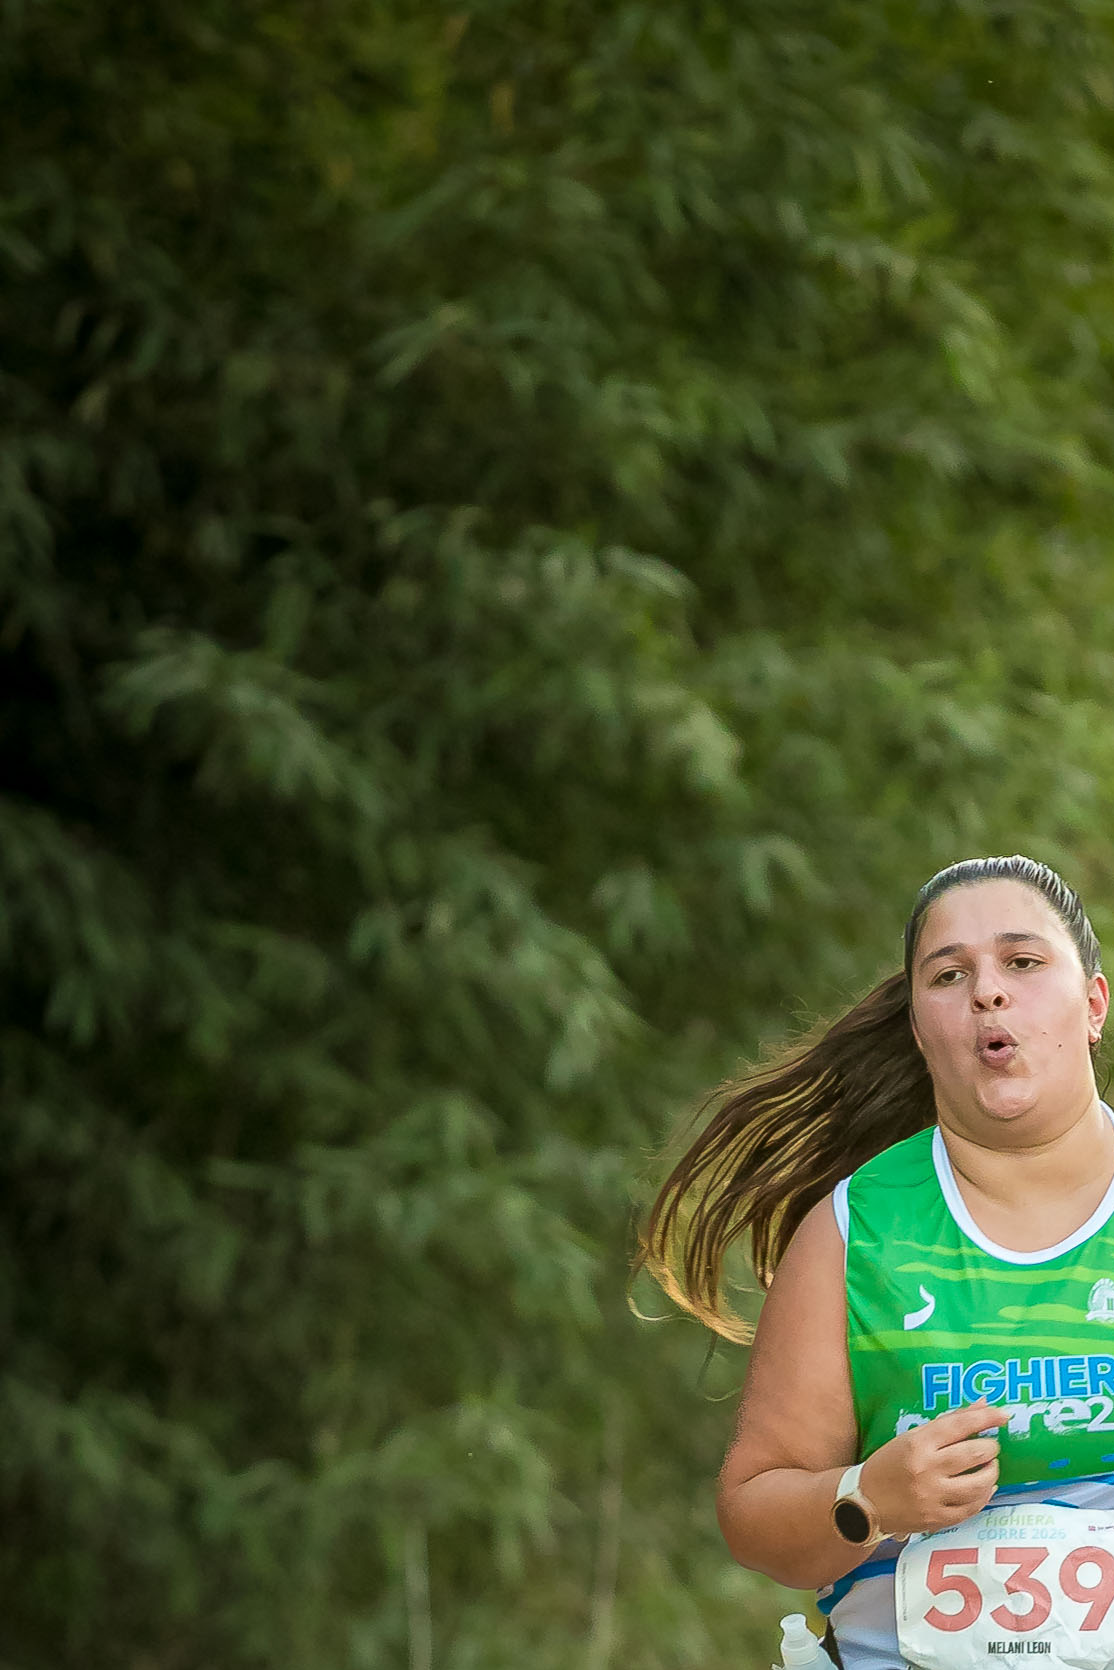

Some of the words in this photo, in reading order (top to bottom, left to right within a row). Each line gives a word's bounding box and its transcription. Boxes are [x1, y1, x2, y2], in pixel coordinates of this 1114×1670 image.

[976, 1528, 1027, 1540] CORRE
[988, 1641, 1024, 1654] MELANI
[1027, 1641, 1051, 1654] LEON
